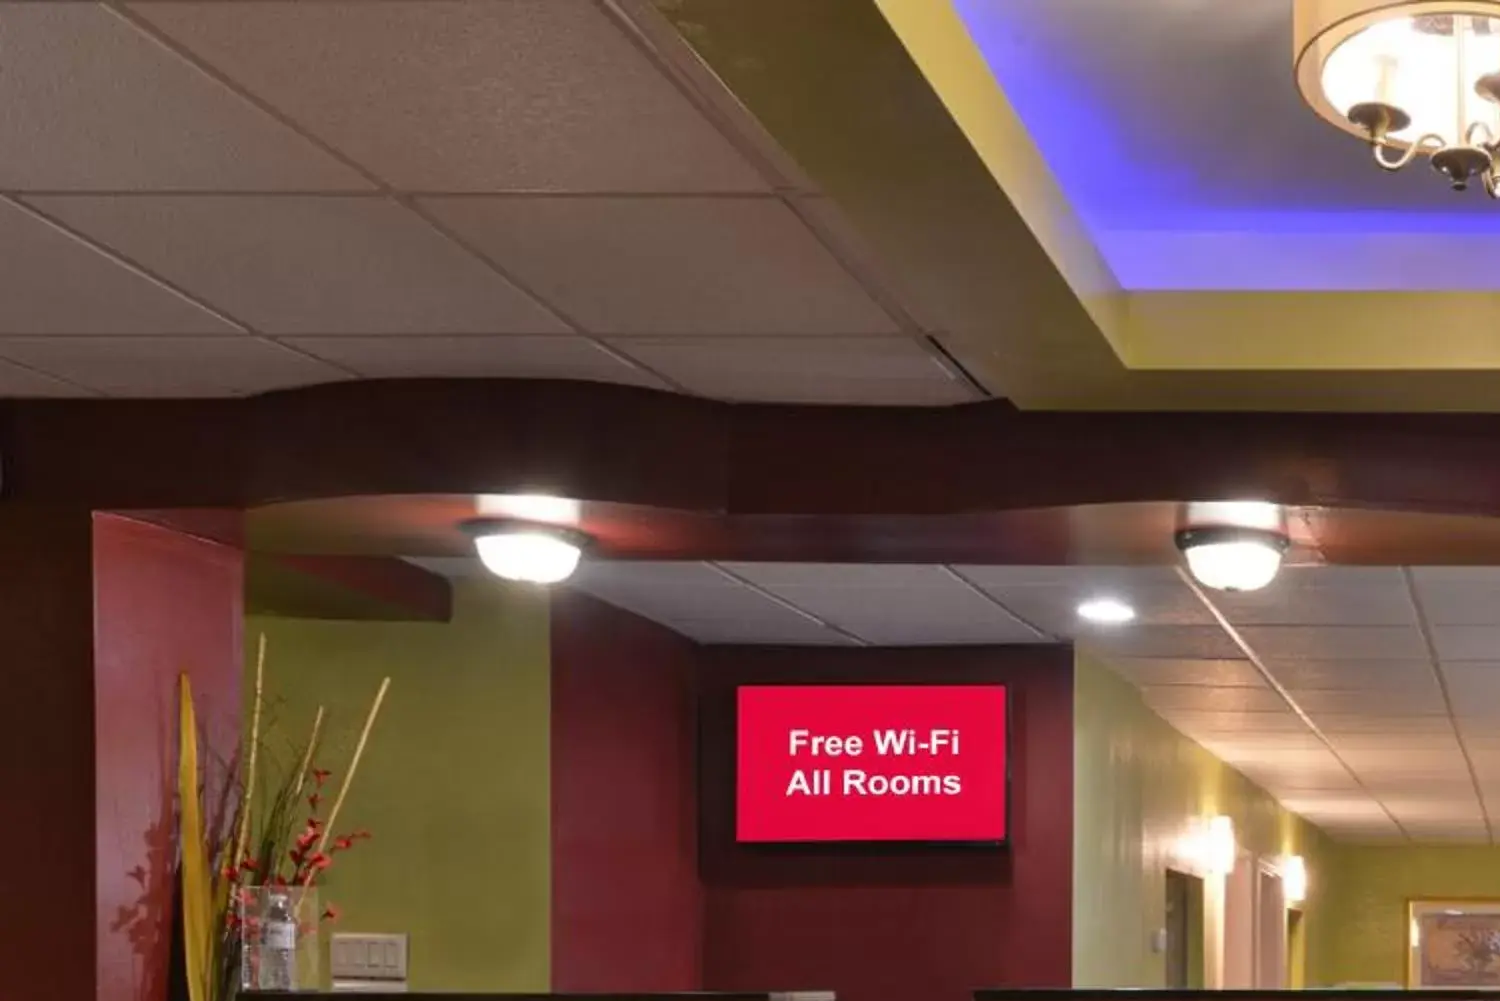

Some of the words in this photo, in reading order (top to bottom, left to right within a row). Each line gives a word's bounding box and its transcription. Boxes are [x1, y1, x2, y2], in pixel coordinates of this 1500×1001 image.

[789, 729, 863, 756] Free
[873, 729, 960, 756] Wi-Fi
[786, 769, 831, 796] All
[843, 769, 961, 796] Rooms
